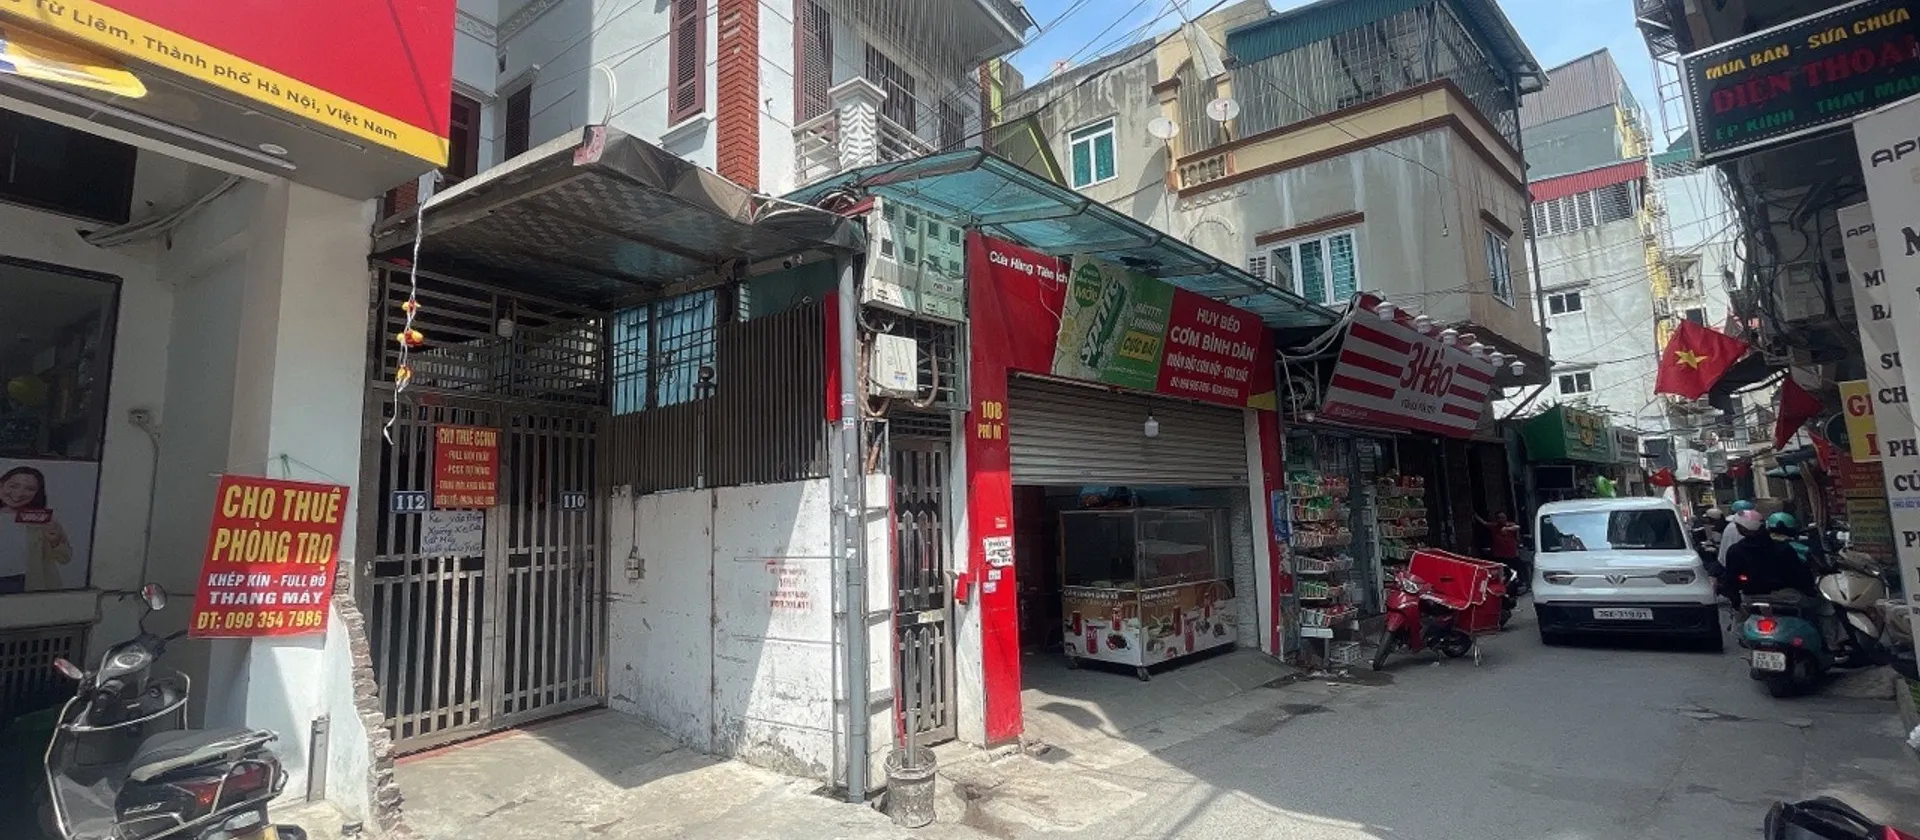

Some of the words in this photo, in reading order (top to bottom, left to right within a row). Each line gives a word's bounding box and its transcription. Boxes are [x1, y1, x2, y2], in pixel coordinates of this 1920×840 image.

[73, 10, 136, 44] Liêm,
[143, 36, 207, 69] Thành
[213, 64, 252, 84] phố
[257, 78, 281, 96] Hà
[286, 89, 321, 114] Nội,
[326, 103, 359, 126] Việt
[364, 119, 398, 140] Nam
[1196, 307, 1219, 327] HUY
[1170, 325, 1200, 348] CƠM
[222, 484, 276, 520] CHO
[281, 487, 341, 524] THUÊ
[396, 494, 426, 510] 112
[563, 495, 585, 508] 110
[211, 521, 292, 564] PHÒNG
[295, 532, 333, 571] TRỌ
[208, 571, 245, 587] KHÉP
[247, 571, 271, 587] KÍN
[280, 574, 306, 587] FULL
[209, 591, 277, 604] THANG
[281, 589, 324, 604] MÁY
[197, 611, 222, 630] ĐT:
[225, 611, 254, 629] 098
[257, 611, 284, 628] 354
